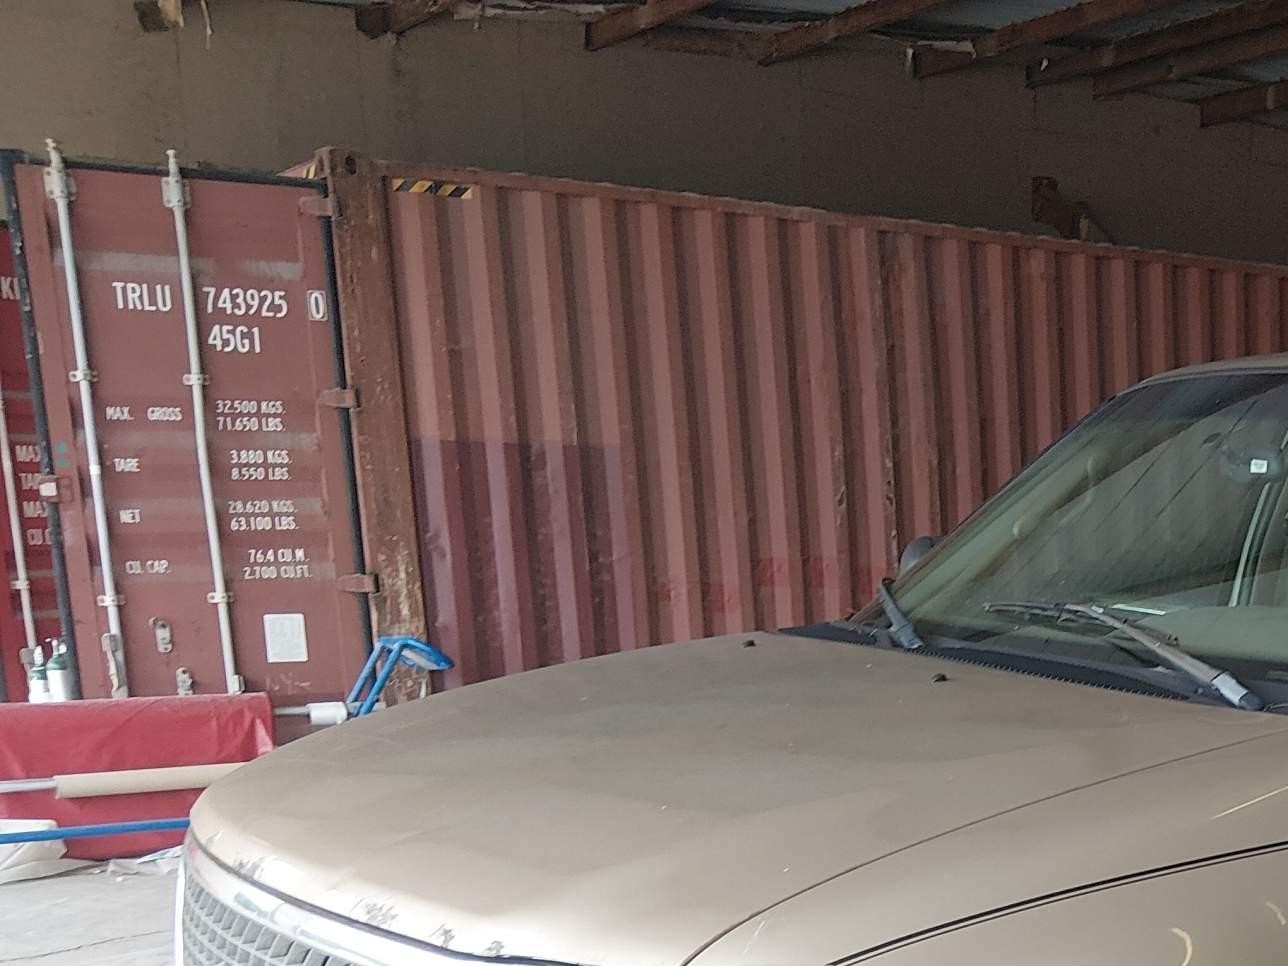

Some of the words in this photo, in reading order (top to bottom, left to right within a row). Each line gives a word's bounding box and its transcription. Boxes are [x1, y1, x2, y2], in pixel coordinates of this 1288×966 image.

[111, 281, 172, 312] TRLU
[202, 286, 288, 318] 743925
[308, 291, 326, 319] 0
[207, 324, 261, 354] 45G1
[147, 406, 183, 421] GROSS
[113, 458, 141, 473] TARE
[119, 509, 141, 524] NET
